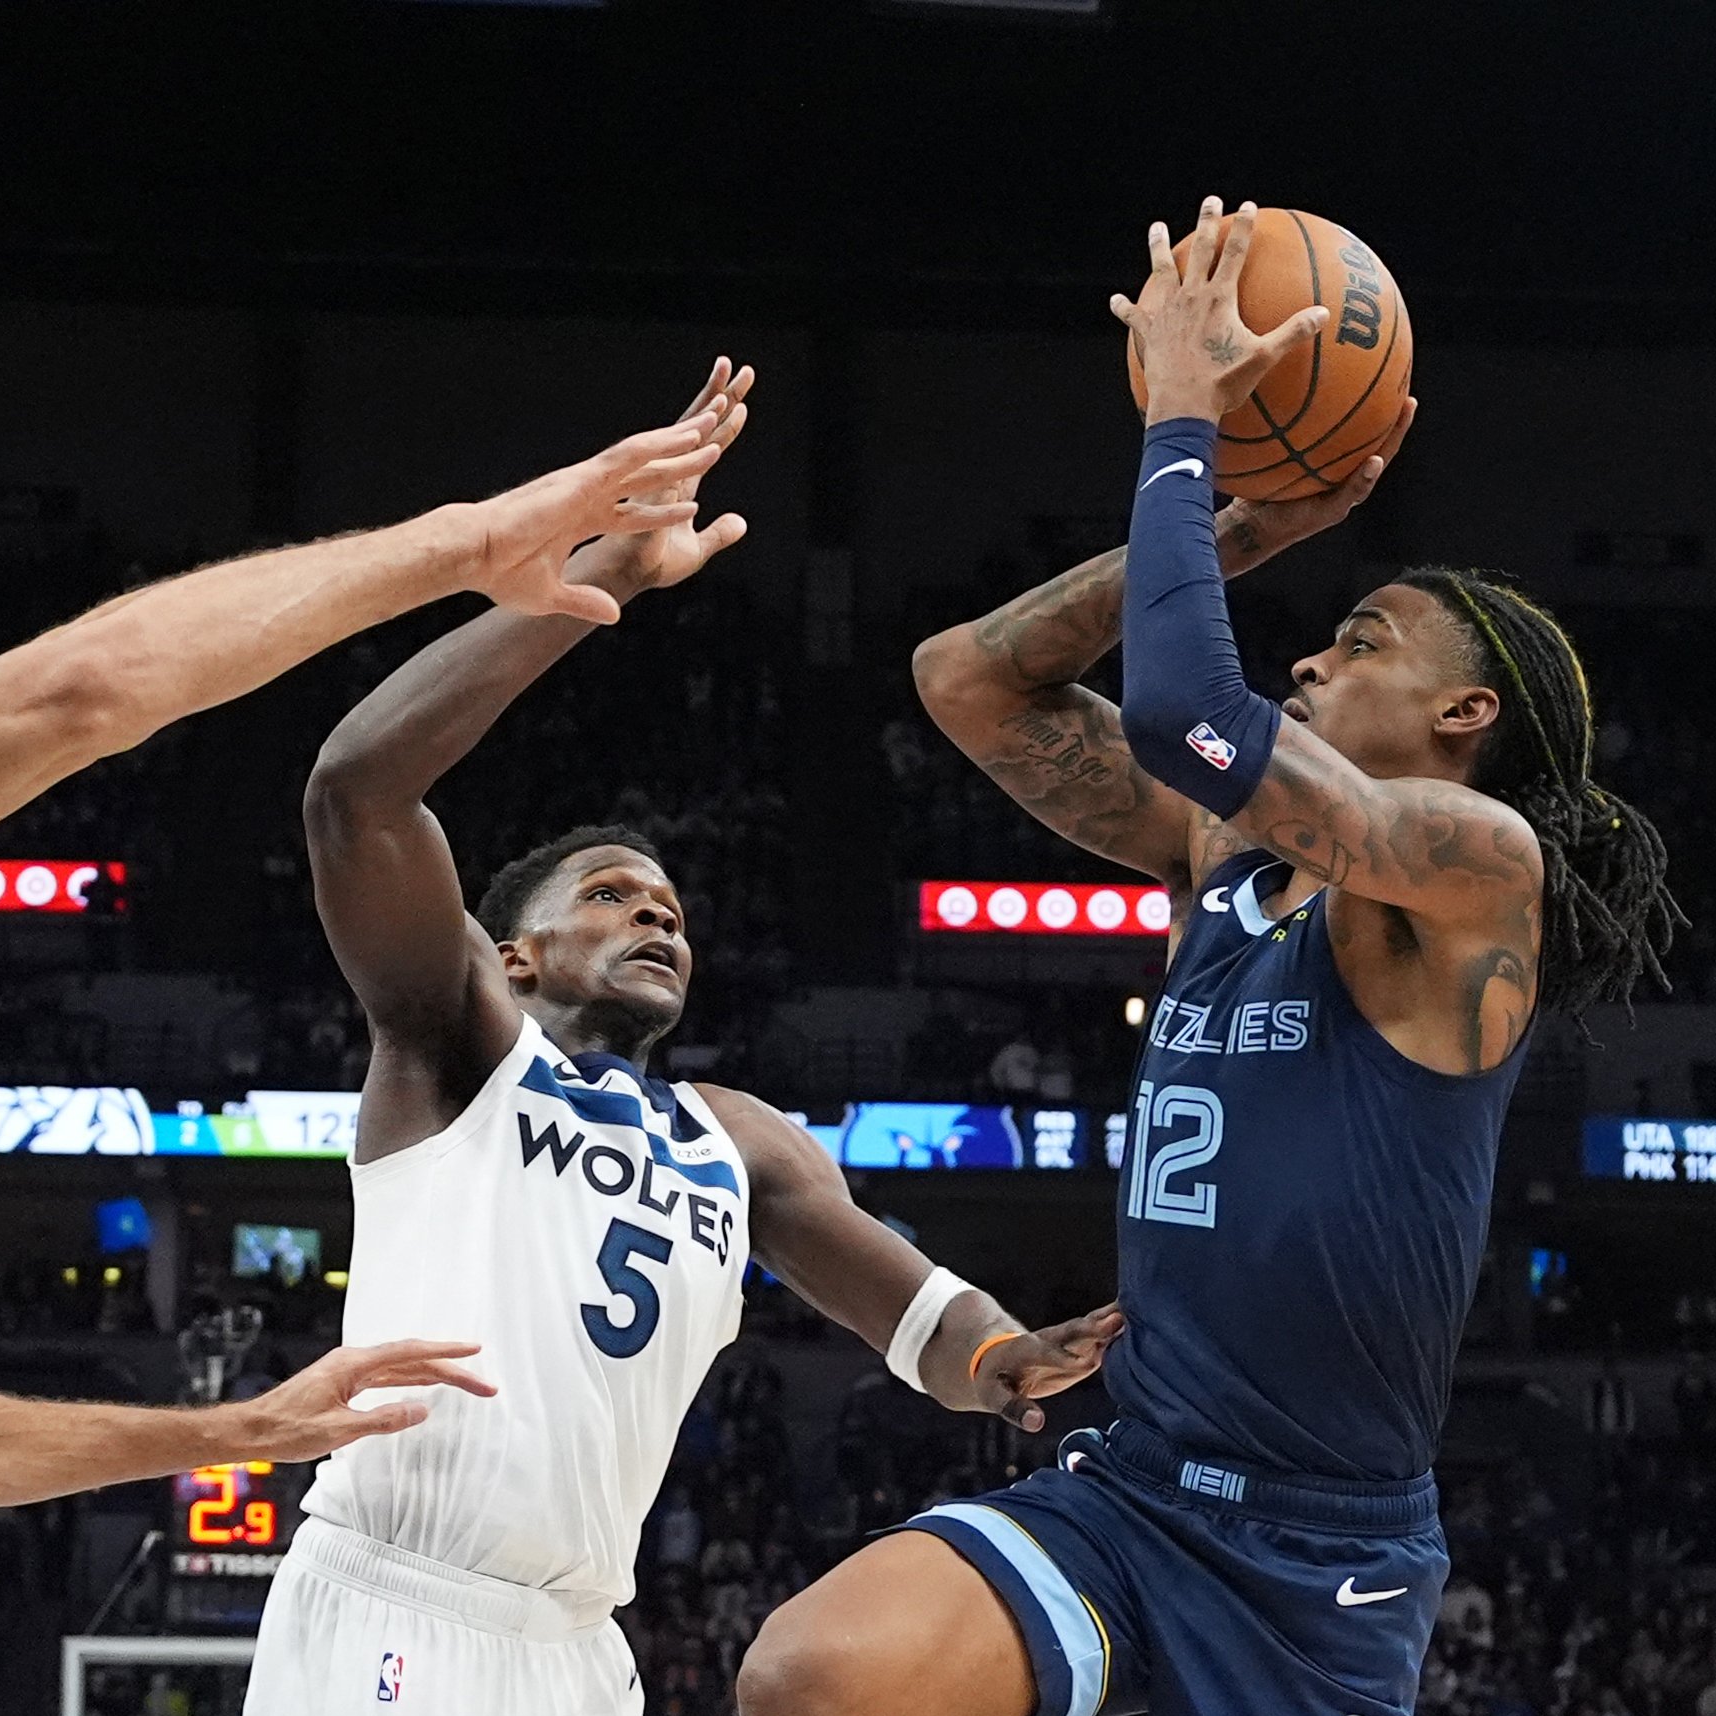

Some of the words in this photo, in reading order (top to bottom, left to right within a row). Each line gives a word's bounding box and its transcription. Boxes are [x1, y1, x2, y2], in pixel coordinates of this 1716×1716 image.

[1127, 1079, 1225, 1229] 12
[1623, 1122, 1676, 1152] UTA
[1623, 1150, 1676, 1181] PHX
[580, 1216, 674, 1359] 5
[188, 1471, 276, 1544] 2.9
